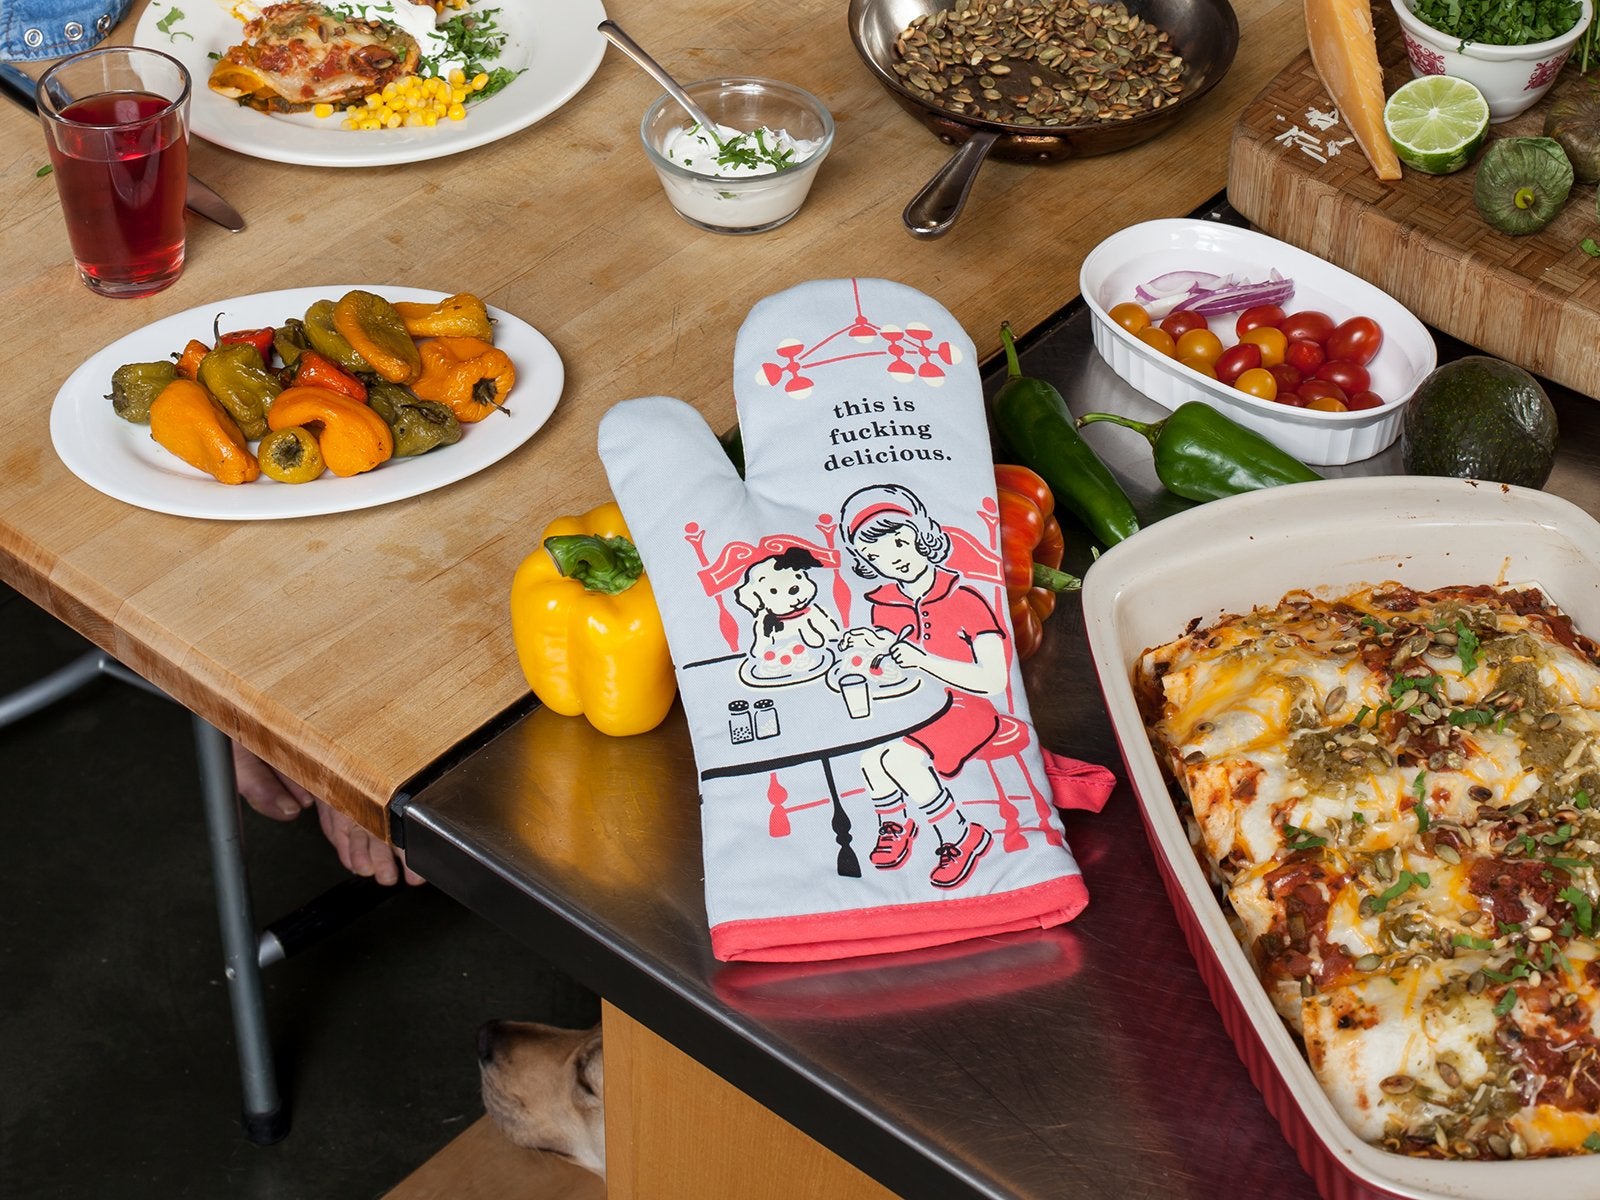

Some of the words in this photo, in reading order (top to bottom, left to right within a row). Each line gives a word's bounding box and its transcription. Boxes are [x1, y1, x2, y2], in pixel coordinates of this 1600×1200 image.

[833, 397, 885, 419] this
[893, 396, 915, 412] is
[829, 420, 932, 445] fucking
[824, 445, 952, 471] delicious.
